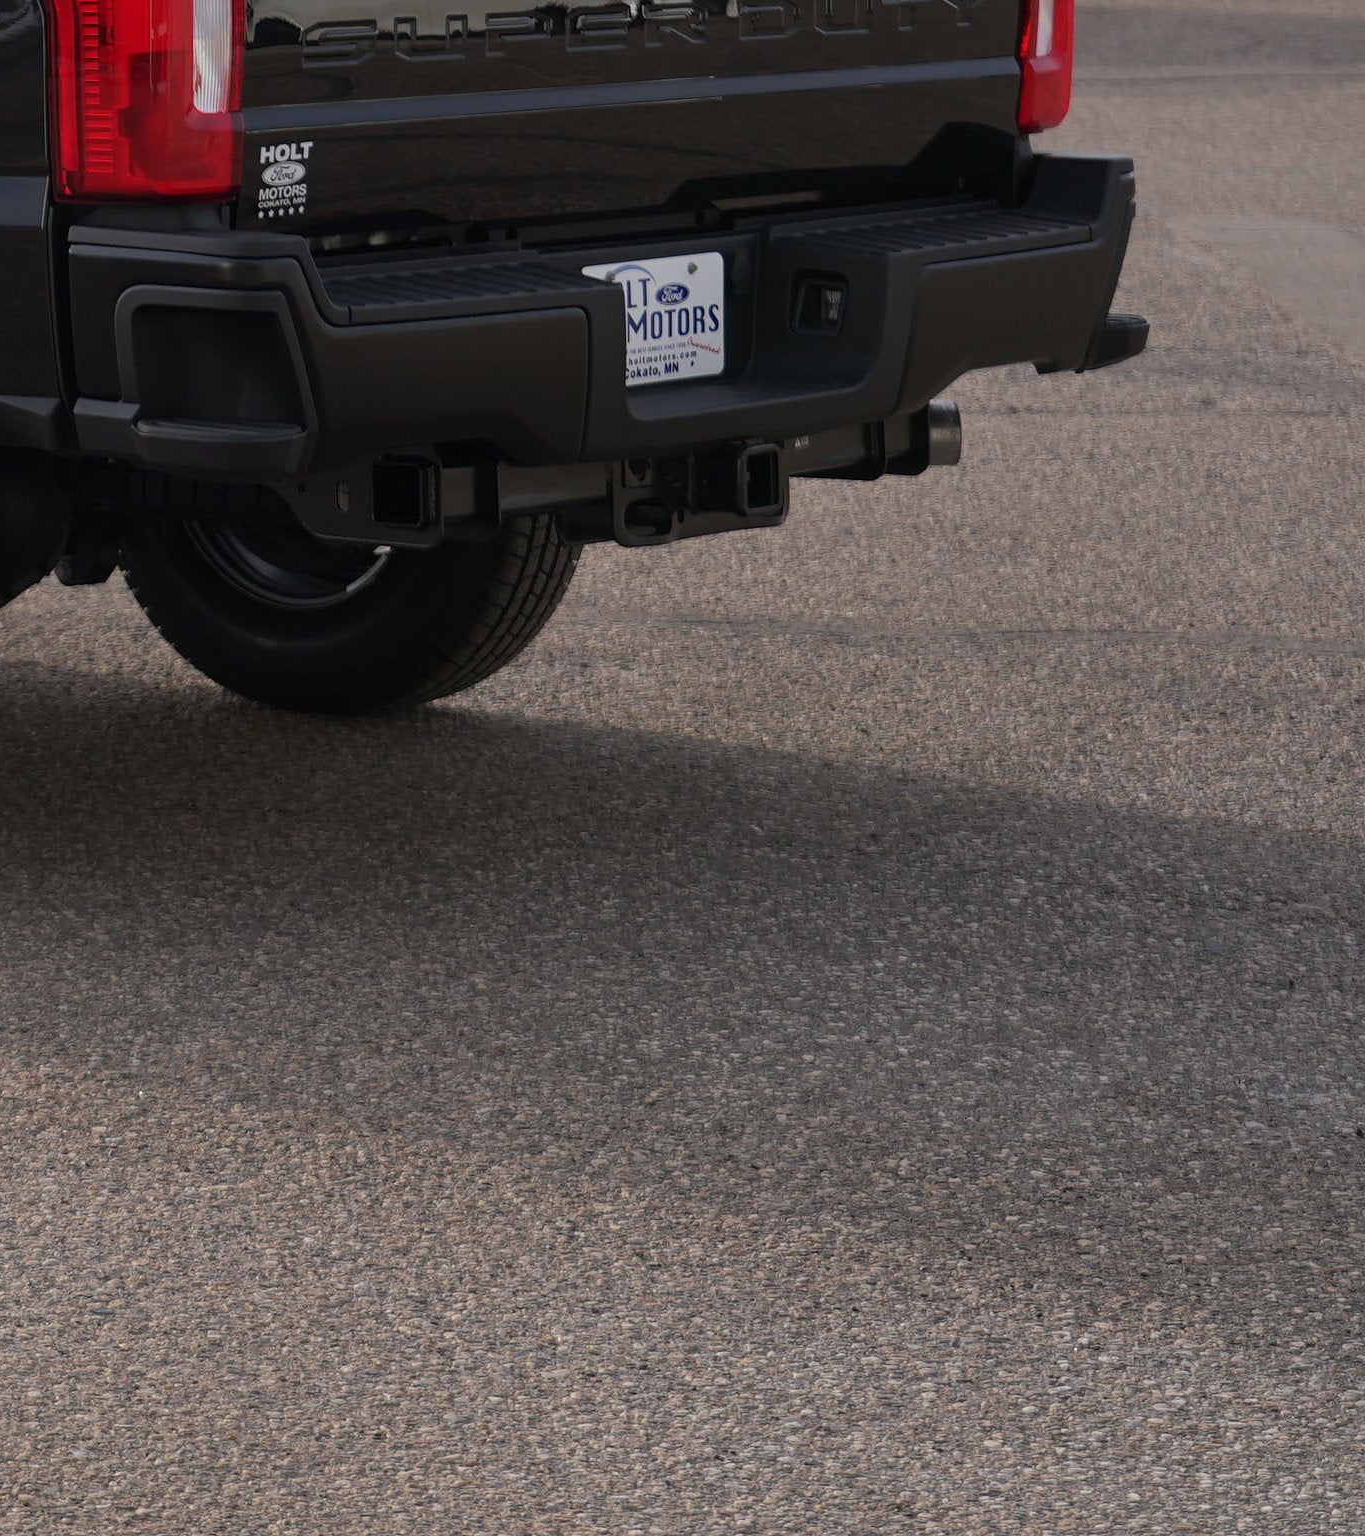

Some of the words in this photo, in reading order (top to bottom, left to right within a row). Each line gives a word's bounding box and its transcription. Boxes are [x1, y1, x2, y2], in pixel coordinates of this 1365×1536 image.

[301, 3, 709, 68] SUPER
[260, 141, 314, 164] HOLT
[258, 183, 308, 201] MOTORS
[292, 196, 306, 205] MN
[626, 278, 651, 309] LT
[627, 304, 720, 343] MOTORS
[628, 350, 697, 366] holtmotors.com
[624, 365, 661, 379] Cokato,
[663, 361, 679, 374] MN
